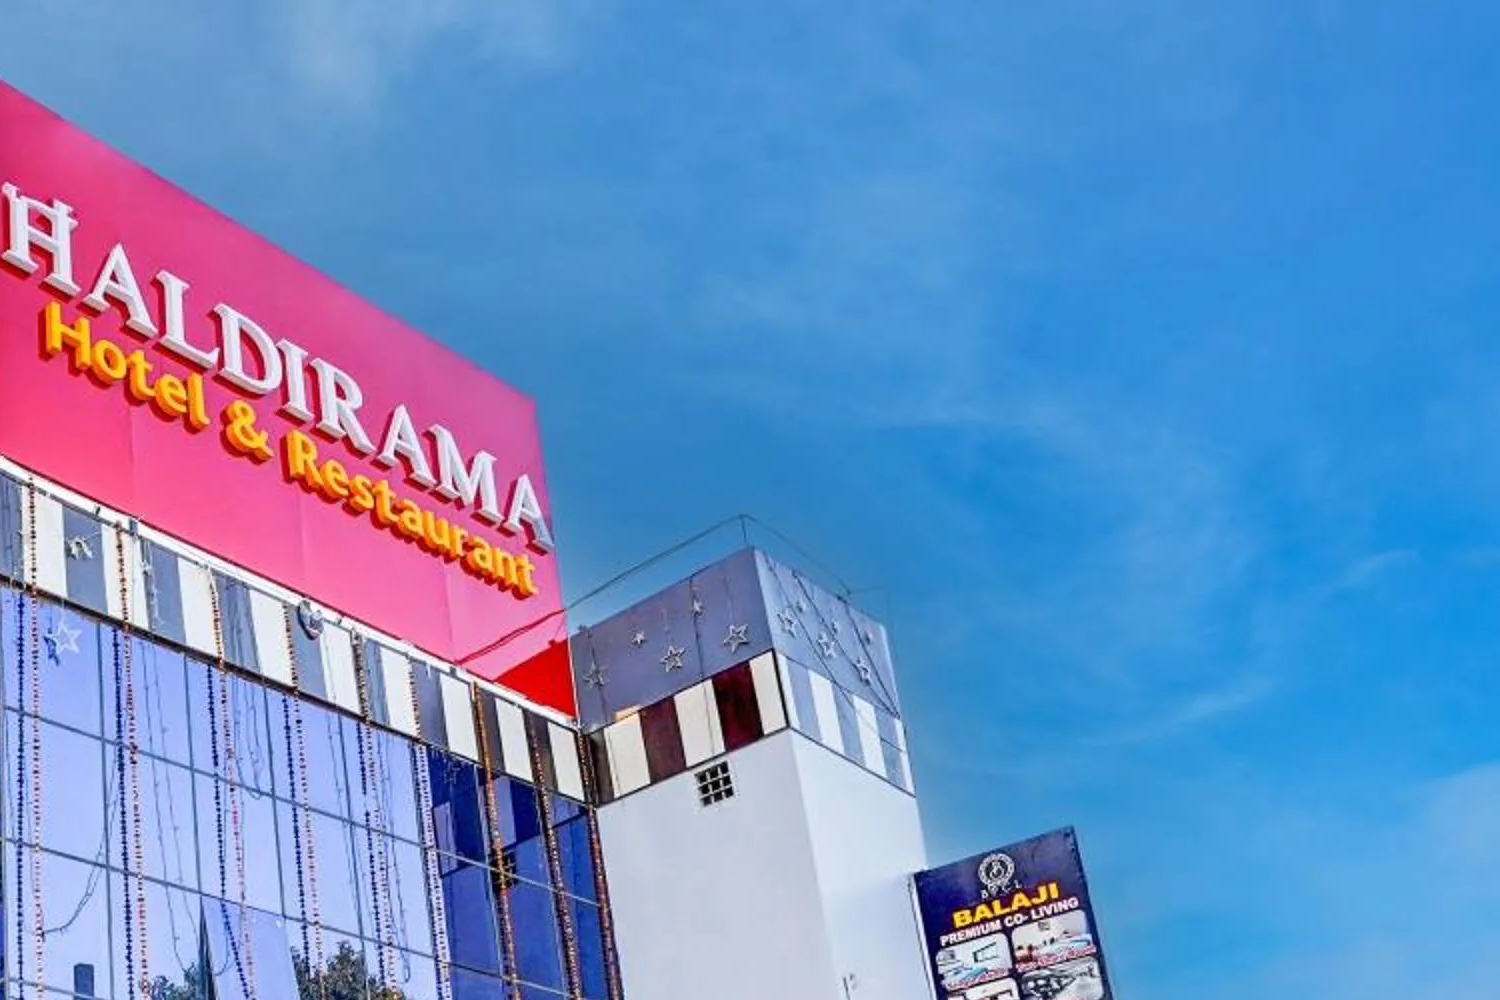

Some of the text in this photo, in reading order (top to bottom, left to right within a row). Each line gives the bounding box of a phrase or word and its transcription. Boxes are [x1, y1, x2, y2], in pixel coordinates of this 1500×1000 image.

[0, 181, 555, 551] HALDIRAMA
[41, 300, 539, 599] Hotel & Restaurant
[940, 919, 1002, 947] PREMIUM
[1031, 896, 1080, 921] LIVING
[952, 880, 1060, 929] BALAJI
